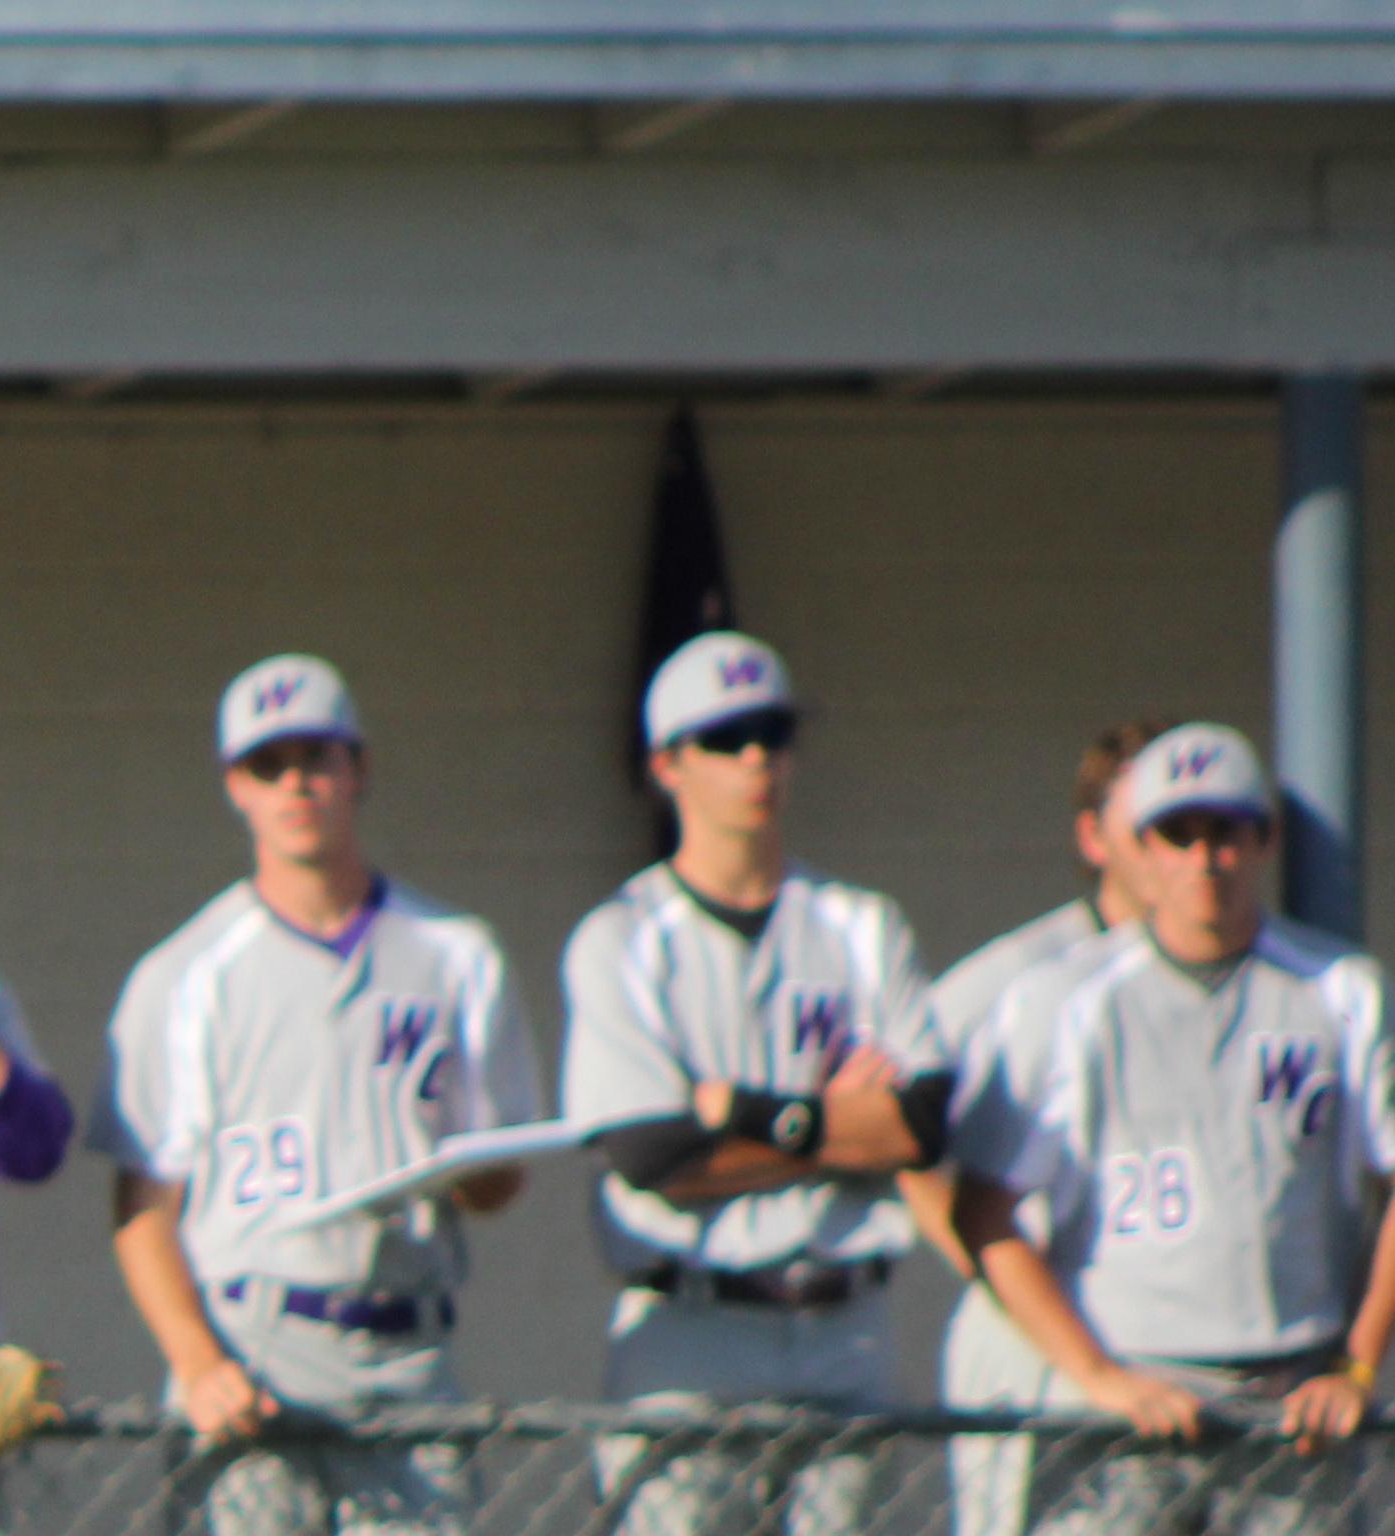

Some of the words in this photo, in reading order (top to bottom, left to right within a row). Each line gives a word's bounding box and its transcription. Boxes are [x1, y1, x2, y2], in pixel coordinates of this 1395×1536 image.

[718, 655, 767, 690] W
[251, 675, 305, 717] W
[1166, 744, 1223, 782] W
[225, 1124, 307, 1207] 29
[1112, 1153, 1192, 1236] 28
